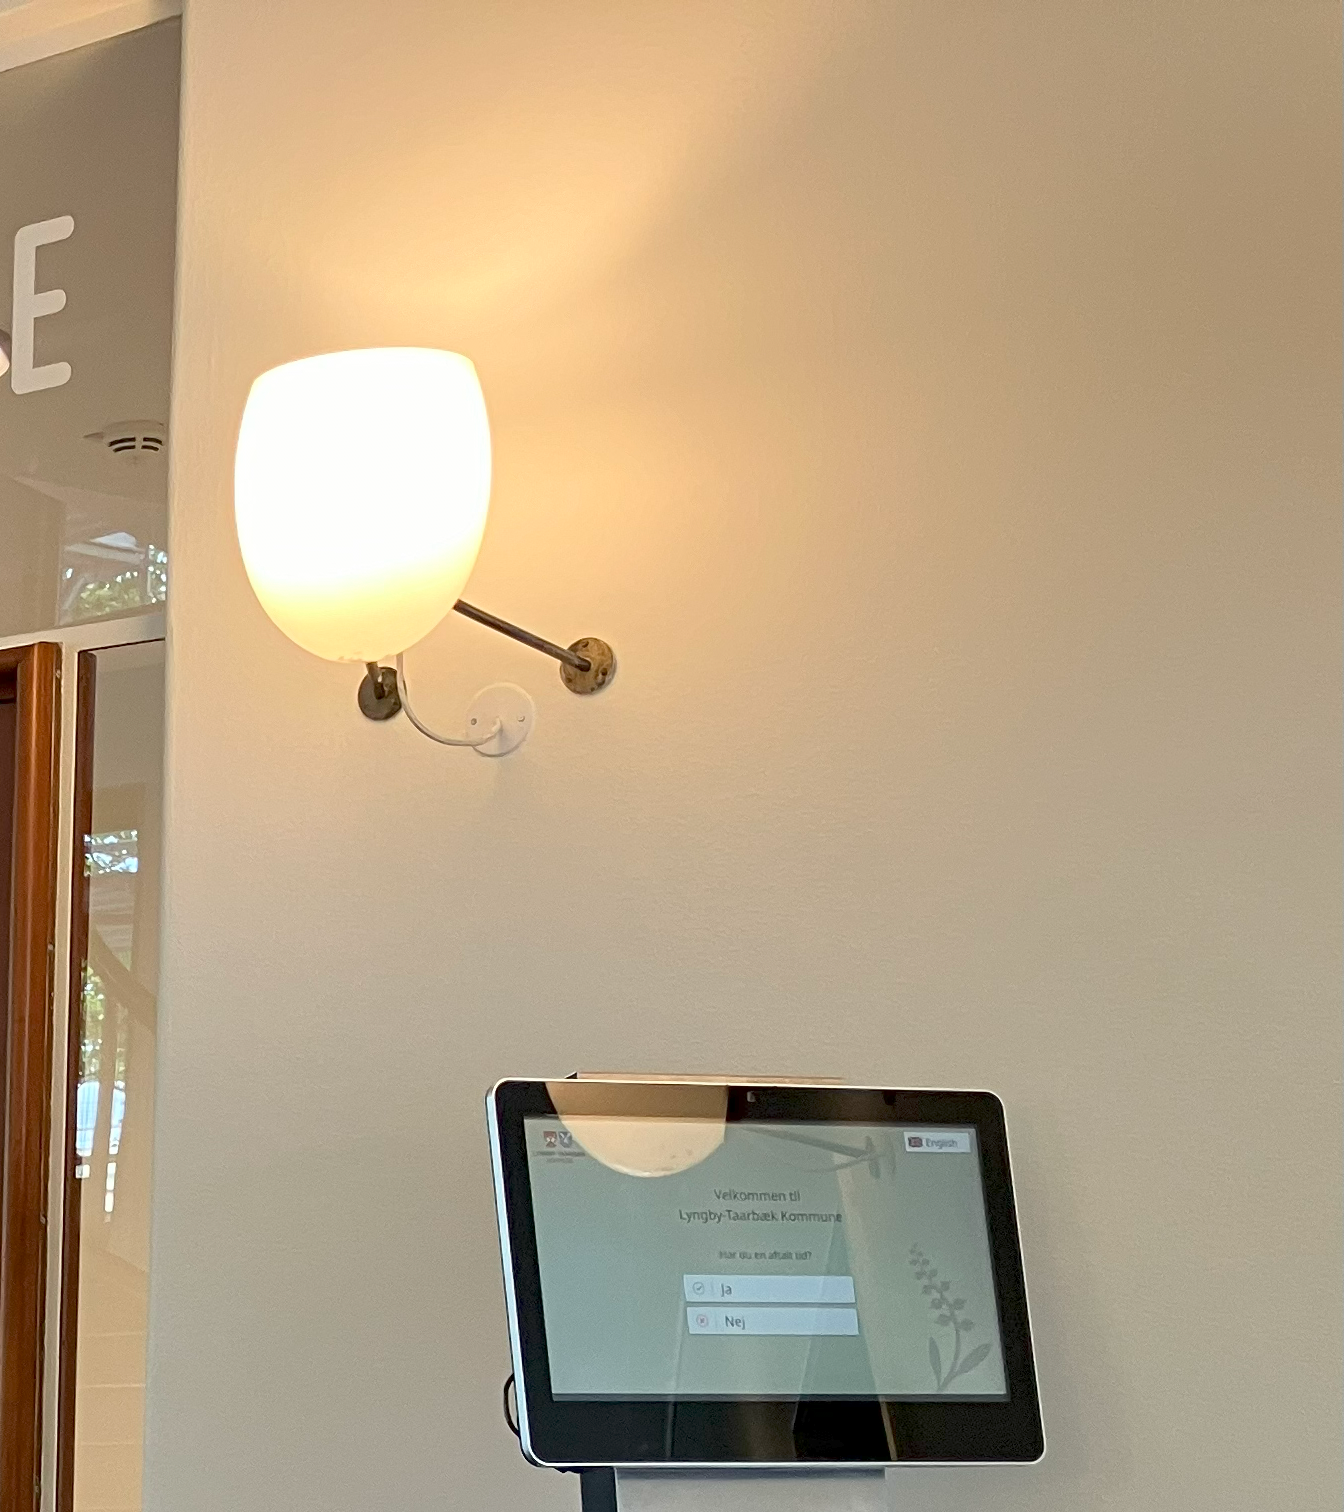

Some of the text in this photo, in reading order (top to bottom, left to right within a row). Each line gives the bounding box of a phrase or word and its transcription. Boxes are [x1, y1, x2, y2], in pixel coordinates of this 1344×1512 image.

[926, 1138, 958, 1149] English
[714, 1189, 800, 1201] Velkommen til
[679, 1209, 842, 1224] Lyngby-Taarbæk Kommune
[720, 1283, 732, 1297] Ja
[725, 1315, 746, 1330] Nej
